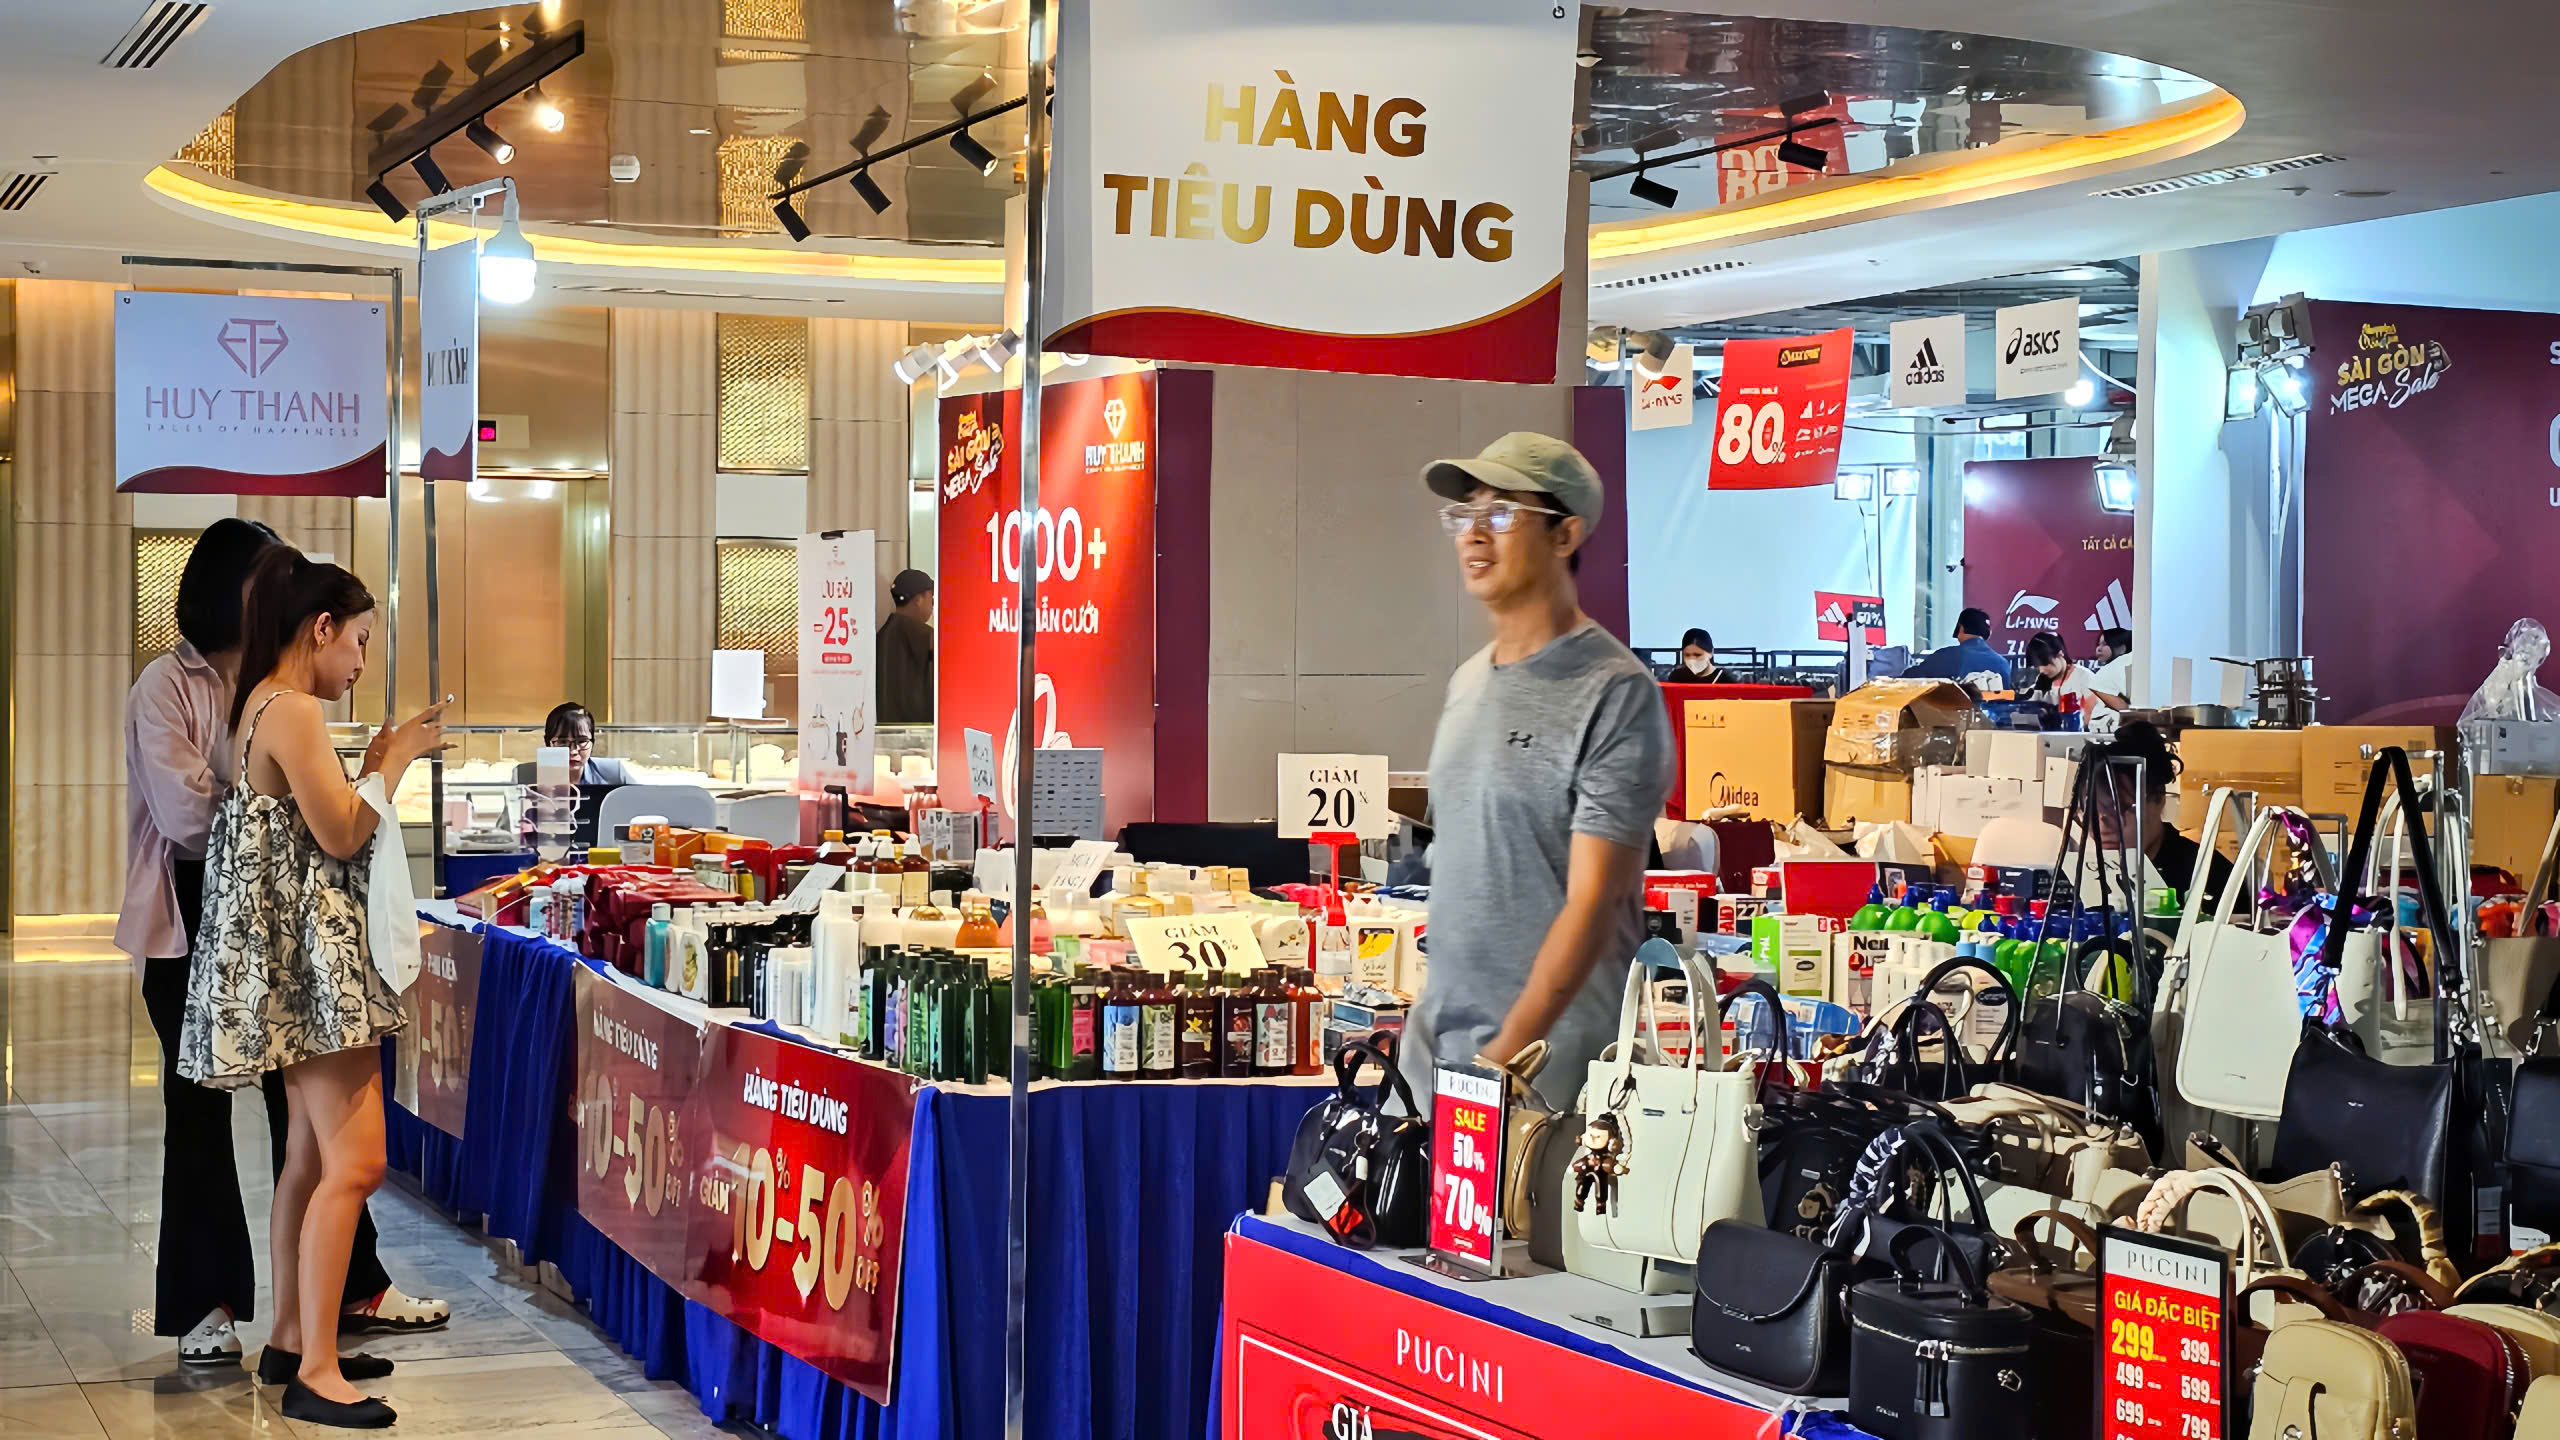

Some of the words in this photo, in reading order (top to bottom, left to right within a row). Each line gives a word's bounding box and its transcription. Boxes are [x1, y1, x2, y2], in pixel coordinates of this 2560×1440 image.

[1204, 69, 1427, 157] HÀNG
[1103, 161, 1272, 244] TIÊU
[1293, 175, 1514, 262] DÙNG
[146, 386, 221, 420] HUY
[230, 389, 360, 424] THANH
[1717, 401, 1787, 465] 80%
[743, 1067, 780, 1112] HÀNG
[781, 1079, 809, 1121] TIÊU
[809, 1086, 849, 1135] DÙNG
[1454, 1107, 1487, 1132] SALE
[1445, 1173, 1492, 1237] 70%
[2127, 1250, 2207, 1285] PUCINI
[2114, 1290, 2143, 1313] GIÁ
[2145, 1296, 2181, 1323] ĐẶC
[2183, 1305, 2220, 1333] BIỆT
[1397, 1327, 1503, 1403] PUCINI
[1331, 1403, 1373, 1440] GIÁ
